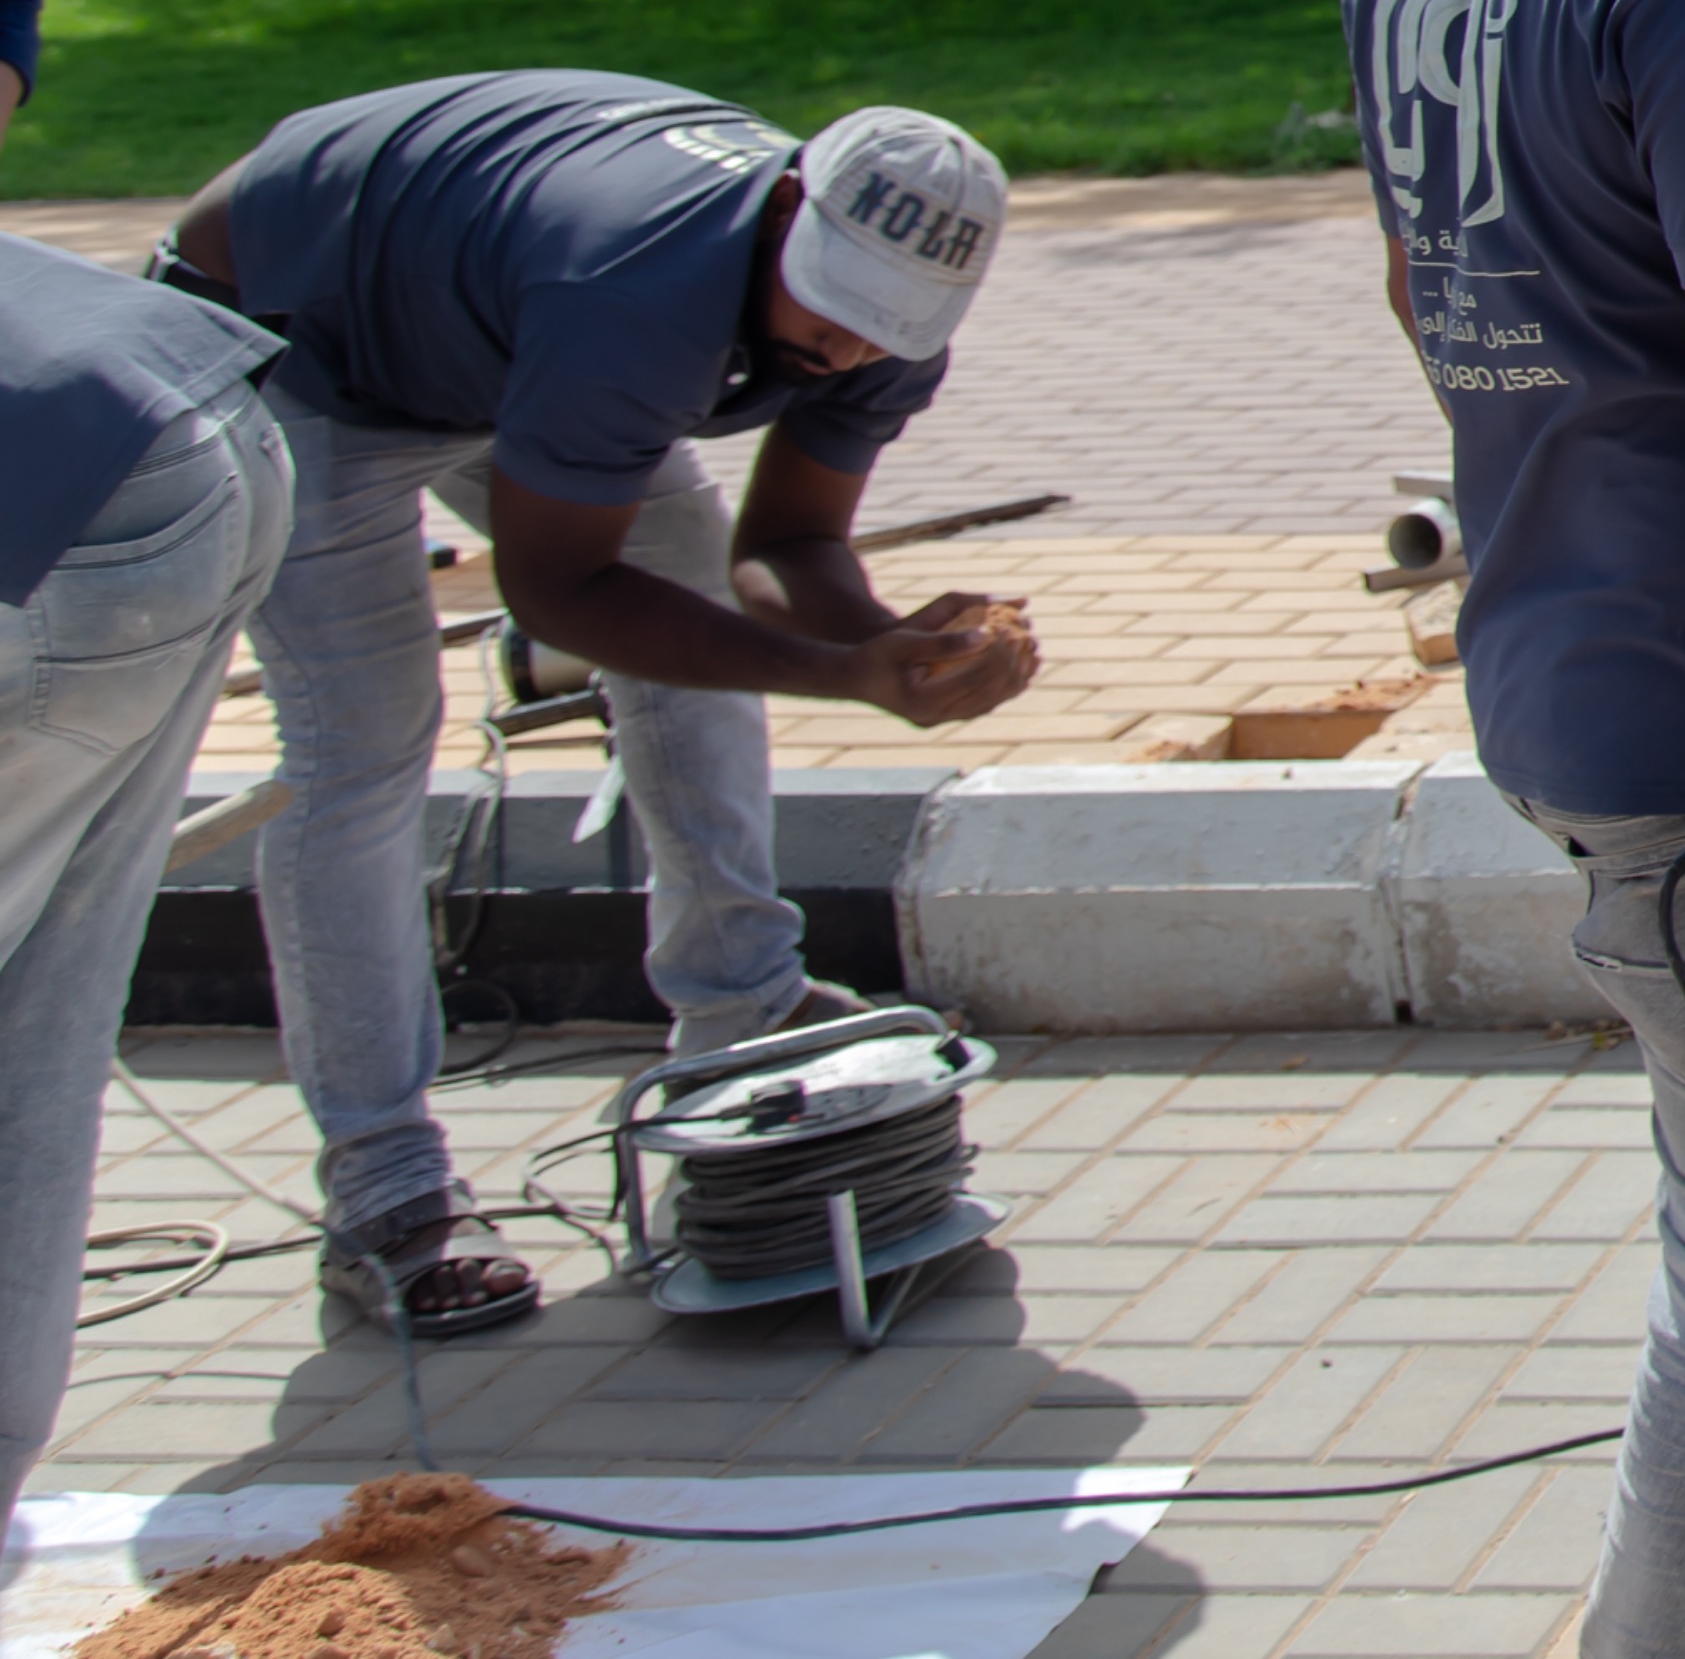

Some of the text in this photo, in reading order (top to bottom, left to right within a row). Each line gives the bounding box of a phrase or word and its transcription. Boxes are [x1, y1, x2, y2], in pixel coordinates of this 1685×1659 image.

[846, 171, 985, 270] NOLA
[1482, 321, 1543, 350] تتحول
[1442, 362, 1496, 391] 080
[1497, 366, 1570, 391] 1521
